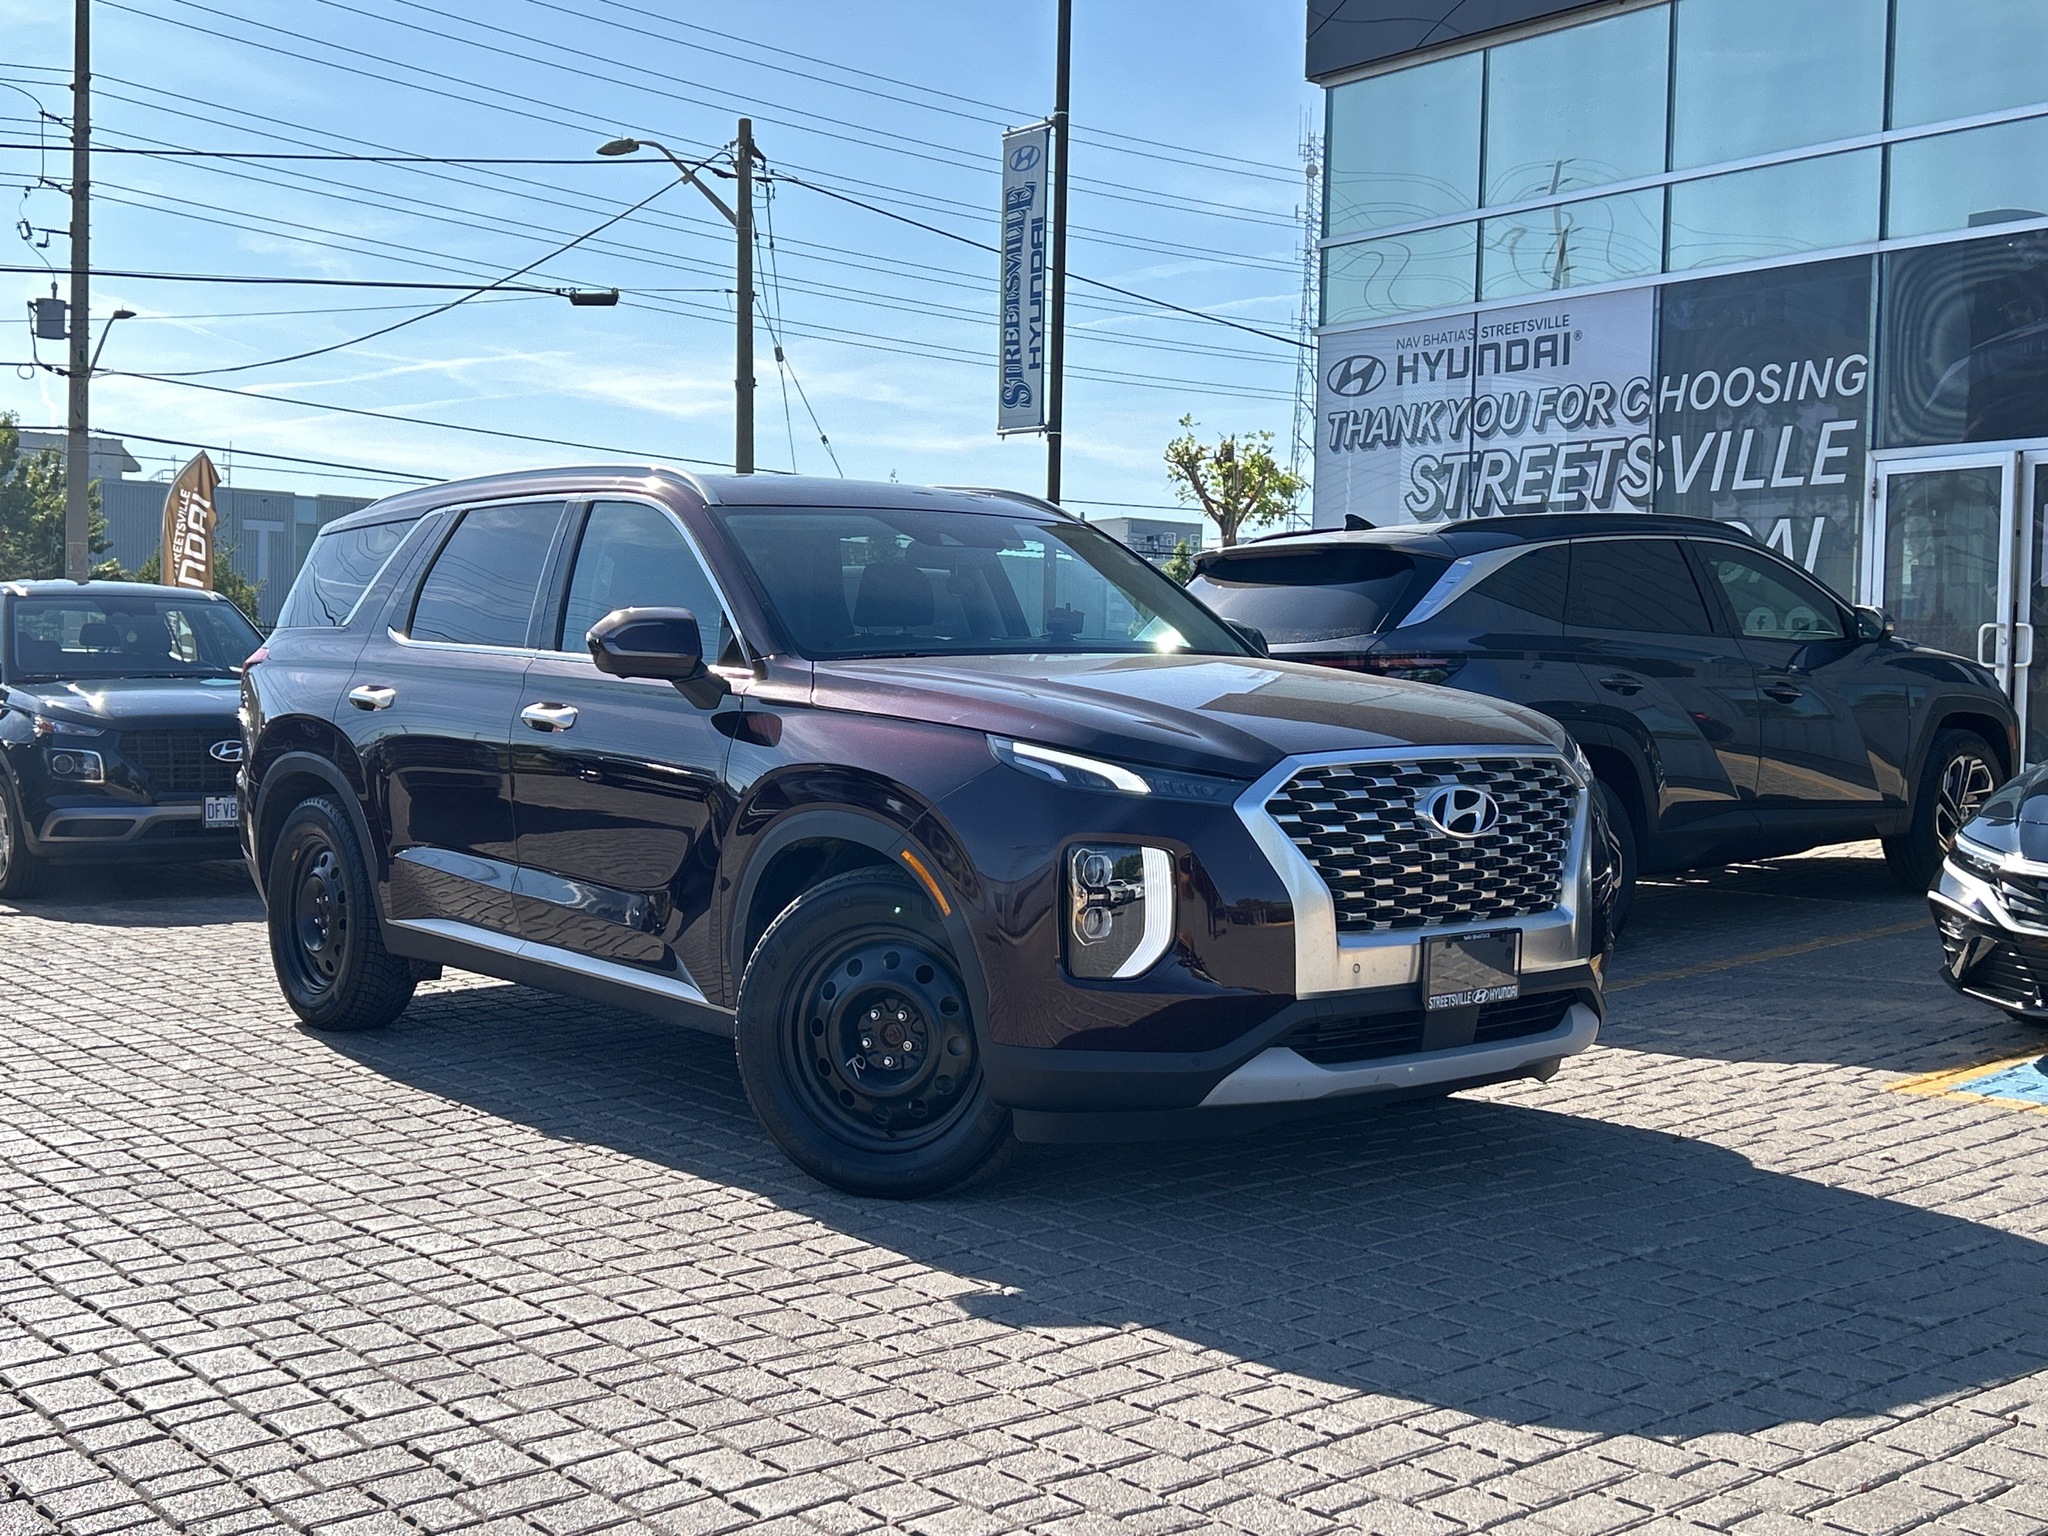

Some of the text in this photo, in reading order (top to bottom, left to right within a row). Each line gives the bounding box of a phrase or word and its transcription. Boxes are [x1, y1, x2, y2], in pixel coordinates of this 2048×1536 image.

[1001, 181, 1036, 408] STREETSVILLE
[1028, 216, 1044, 370] HYUNDAI
[1395, 336, 1421, 350] NAV
[1480, 315, 1570, 339] STREETSVILLE
[1327, 353, 1868, 451] THANK YOU FOR CHOOSING
[1403, 418, 1858, 519] STREETSVILLE
[173, 488, 190, 577] REETSVILLE
[207, 802, 238, 819] DFVB
[1428, 985, 1518, 1009] STREETSVILLE HYUNDAI
